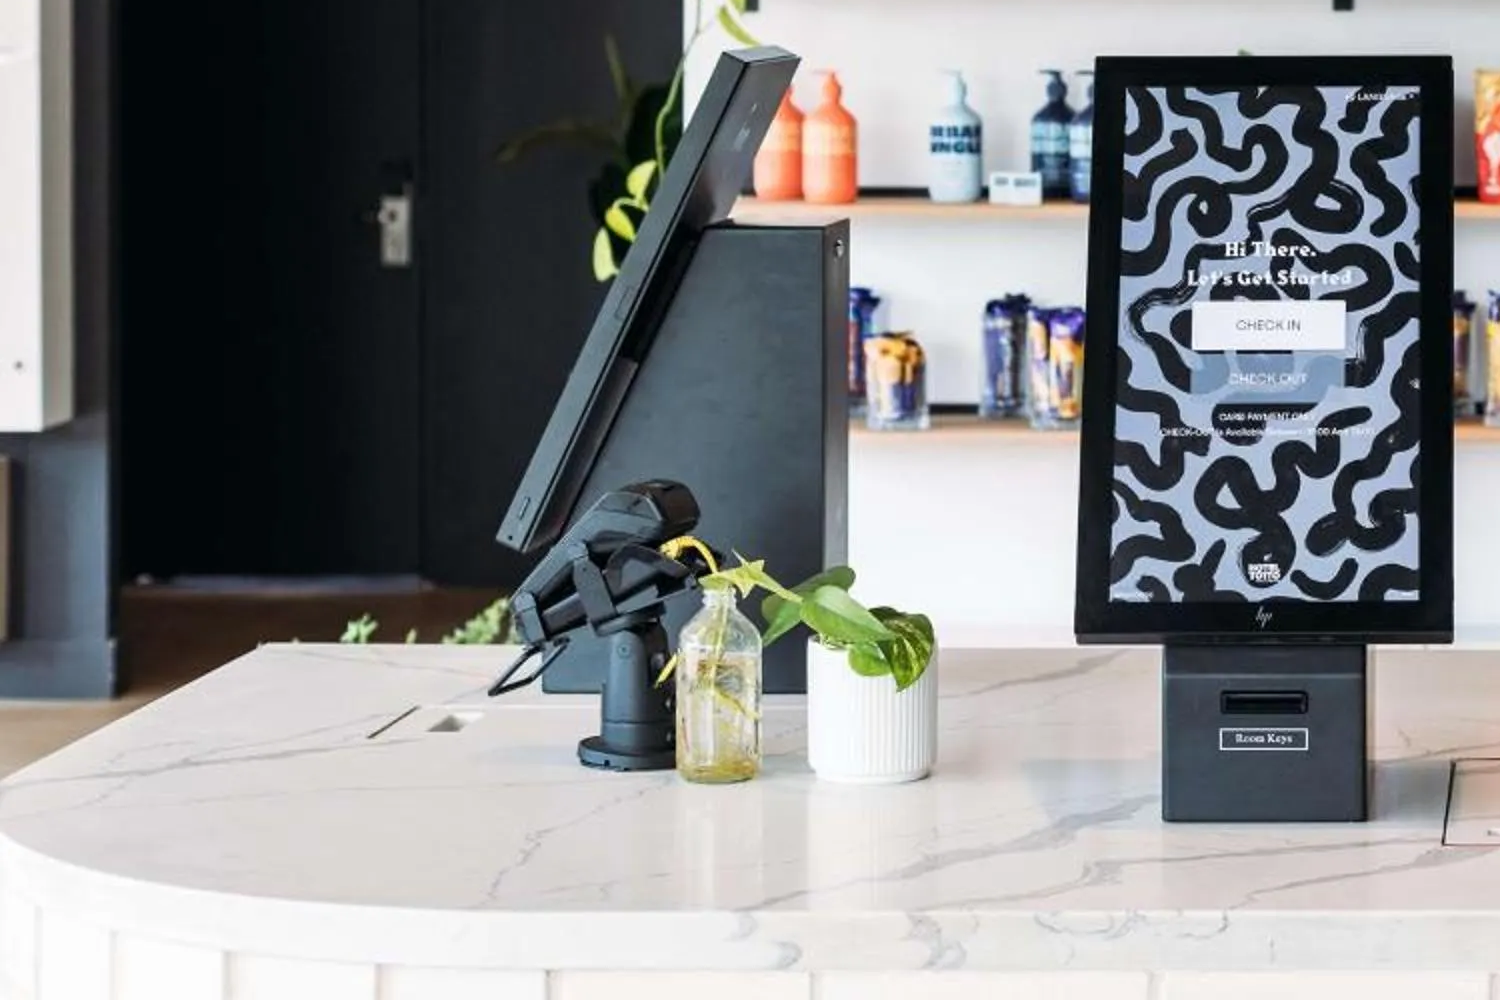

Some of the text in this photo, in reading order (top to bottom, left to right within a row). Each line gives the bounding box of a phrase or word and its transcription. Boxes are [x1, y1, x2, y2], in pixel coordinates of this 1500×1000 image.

[1225, 241, 1317, 257] Hi There.
[1187, 269, 1351, 286] Let's Get Started
[1235, 319, 1301, 331] CHECK IN
[1235, 733, 1293, 745] Room Keys
